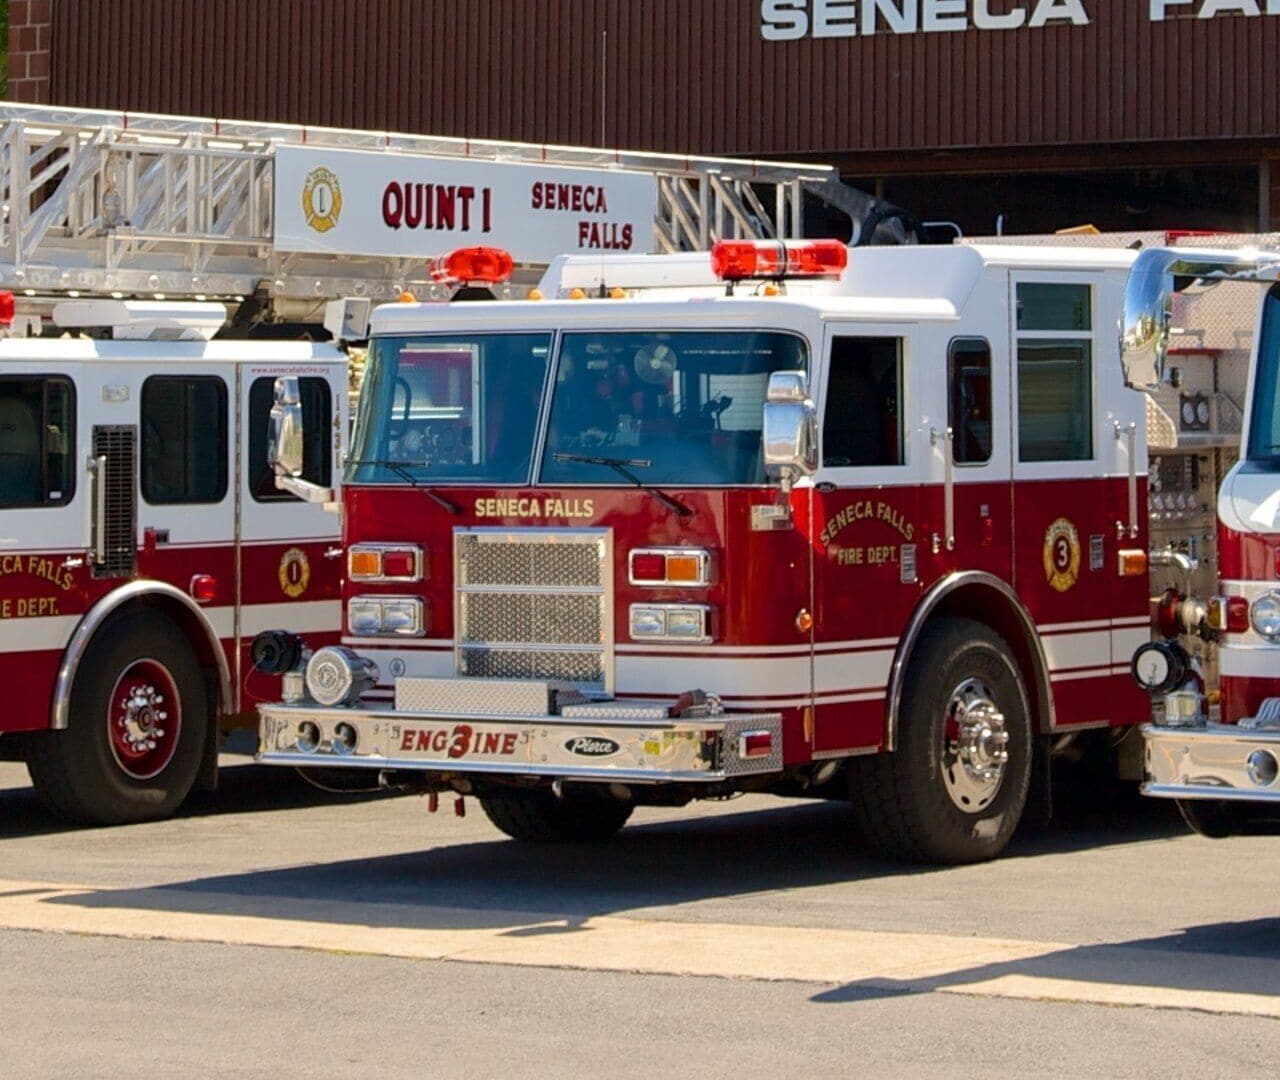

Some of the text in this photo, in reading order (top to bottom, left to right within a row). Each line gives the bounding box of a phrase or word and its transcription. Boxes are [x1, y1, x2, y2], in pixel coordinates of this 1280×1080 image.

[382, 181, 491, 232] QUINT 1
[531, 181, 607, 214] SENECA
[578, 221, 633, 251] FALLS
[475, 498, 594, 518] SENECA FALLS
[820, 501, 915, 548] SENECA FALLS
[837, 547, 864, 565] FIRE
[1058, 540, 1068, 568] 3
[27, 556, 74, 591] FALLS
[17, 597, 59, 617] DEPT.
[571, 736, 614, 754] Pierce
